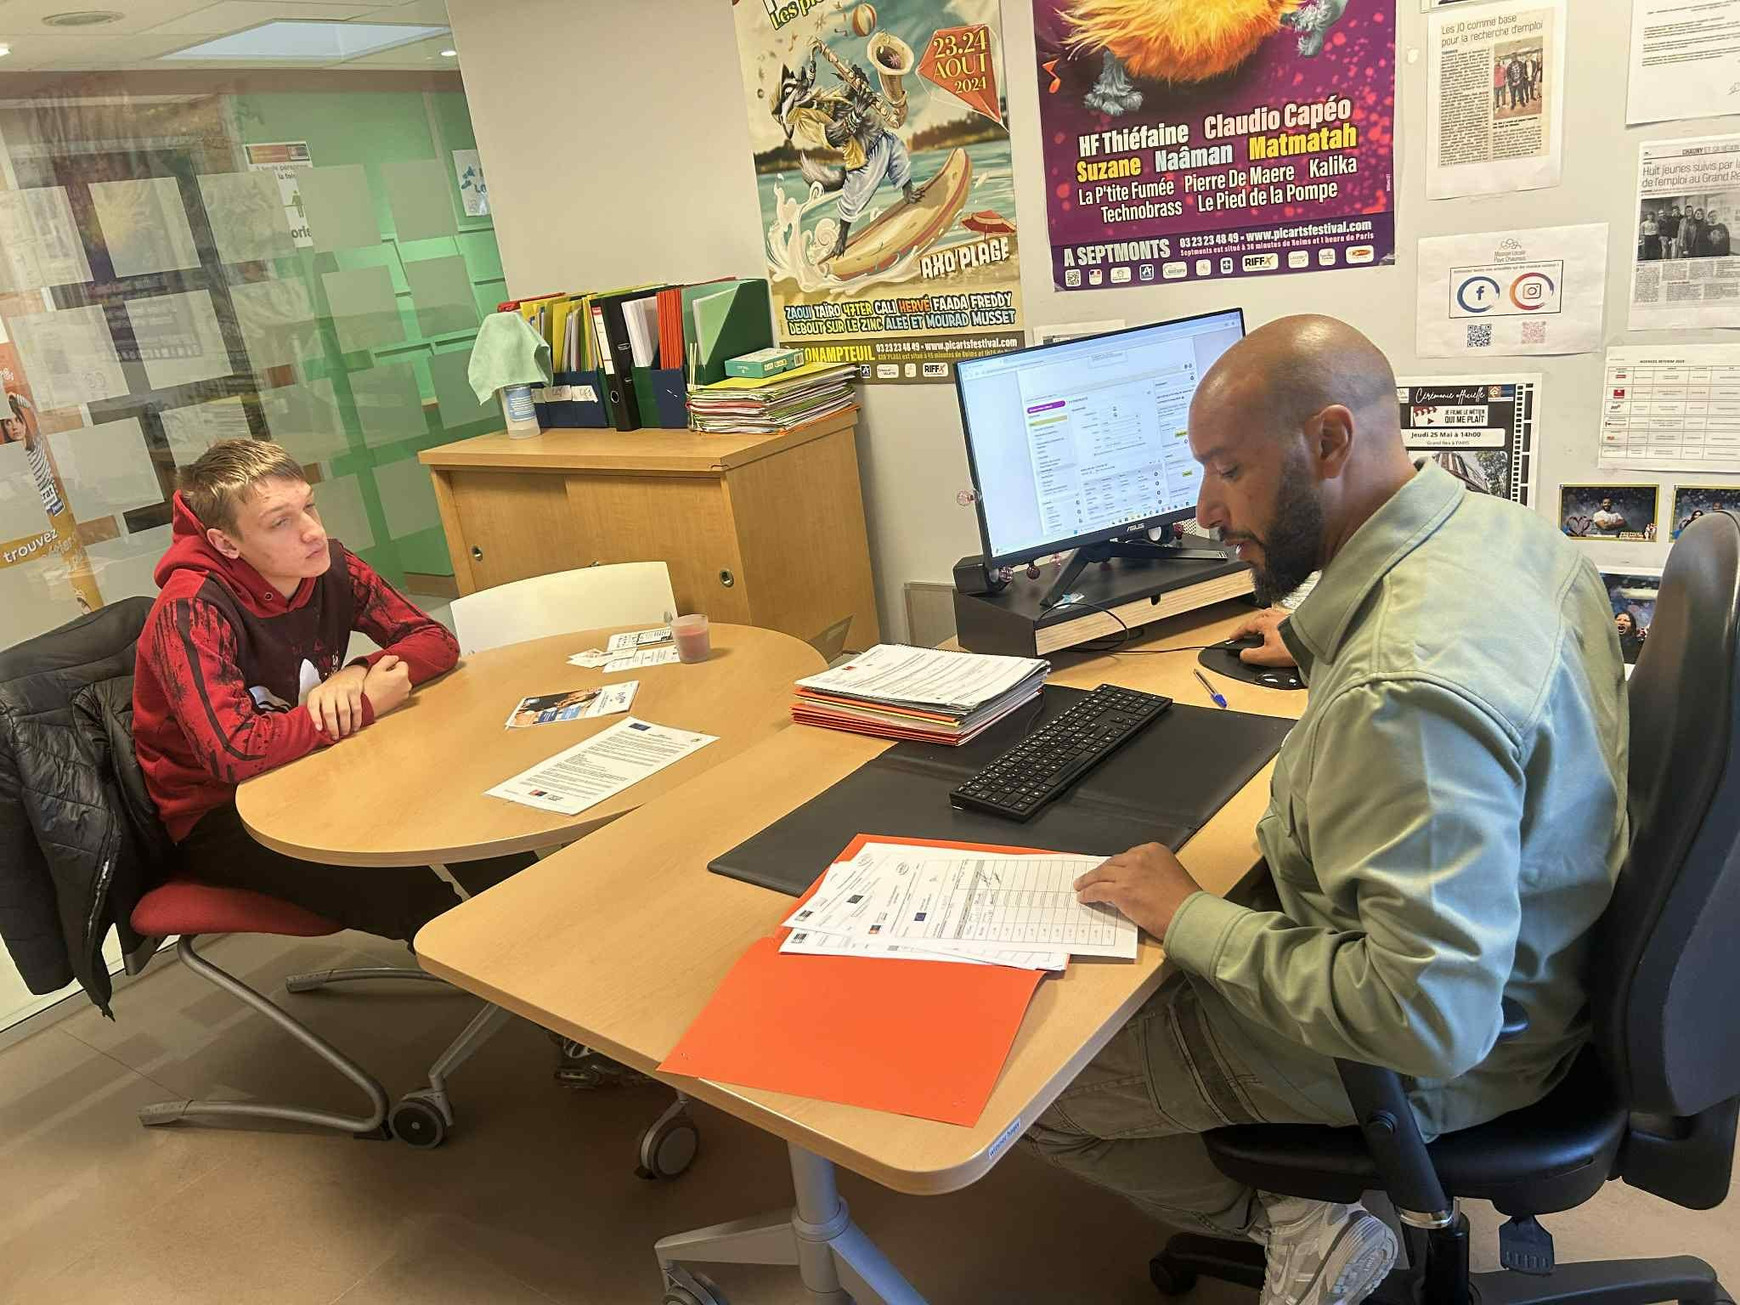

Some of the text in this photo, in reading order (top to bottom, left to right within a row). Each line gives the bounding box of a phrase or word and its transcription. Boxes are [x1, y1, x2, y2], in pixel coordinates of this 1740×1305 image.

[769, 1, 799, 30] Les
[1441, 27, 1455, 35] Les
[1467, 18, 1496, 31] comme
[1498, 14, 1517, 25] base
[933, 29, 987, 58] 23.24
[1441, 36, 1460, 48] pour
[1470, 28, 1510, 41] recherche
[1511, 20, 1543, 34] d'emploi
[955, 76, 987, 94] 2024
[1204, 94, 1352, 139] Claudio Capéo
[1079, 123, 1190, 157] HF Thiéfaine
[1249, 122, 1358, 161] Matmatah
[1076, 145, 1233, 182] Suzane Naâman
[1309, 154, 1358, 178] Kalika
[1643, 166, 1660, 176] Huit
[1661, 163, 1692, 177] jeunes
[1694, 161, 1717, 171] suivis
[1719, 161, 1734, 172] par
[1078, 178, 1175, 206] La P'tite Fumée
[1184, 165, 1295, 193] Pierre De Maere
[1642, 179, 1653, 188] de
[1689, 175, 1700, 184] au
[1702, 172, 1729, 183] Grand
[1197, 181, 1339, 212] Le Pied de la Pompe
[1101, 200, 1183, 223] Technobrass
[1180, 237, 1191, 248] 03
[1191, 236, 1203, 247] 23
[1203, 234, 1215, 246] 23
[1215, 233, 1227, 245] 48
[1227, 232, 1240, 244] 49
[1246, 220, 1372, 242] www.picartsfestival.com
[1356, 231, 1374, 240] Paris
[1064, 238, 1171, 267] A SEPTMONTS
[785, 292, 1012, 321] ZAOUI TAÏRO 47TER CALI HERVÉ FAADA FREDDY
[788, 320, 824, 335] DEBOUT
[825, 319, 845, 334] SUR
[846, 318, 860, 332] LE
[860, 316, 884, 332] ZINC
[910, 314, 924, 330] ET
[924, 312, 970, 329] MOURAD
[971, 309, 1017, 327] MUSSET
[804, 345, 876, 362] ONAMPTEUIL
[3, 529, 58, 563] trouvez
